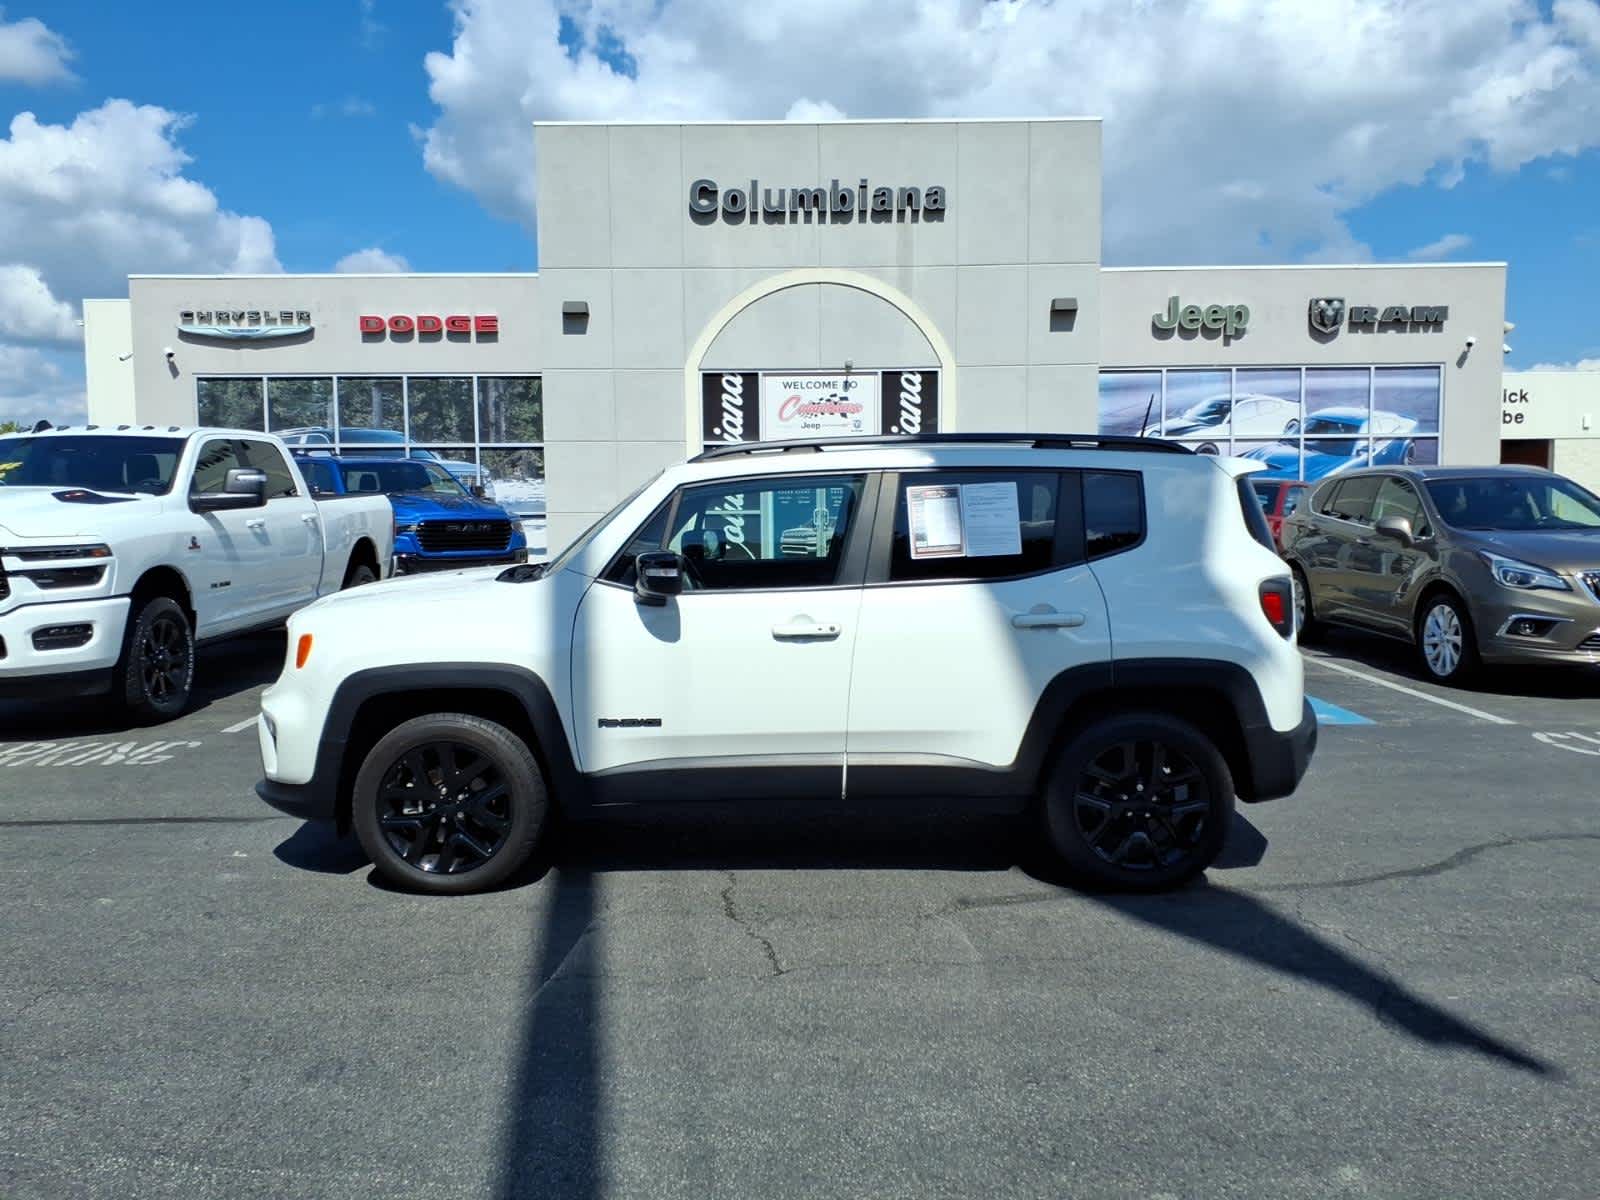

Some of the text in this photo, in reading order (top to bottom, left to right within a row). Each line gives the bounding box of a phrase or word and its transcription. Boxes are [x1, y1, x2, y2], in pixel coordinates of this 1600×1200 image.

[689, 178, 946, 214] Columbiana
[180, 311, 310, 322] CHRYSLER
[1151, 295, 1250, 336] Jeep
[1349, 305, 1449, 322] RAM
[359, 315, 499, 332] DODGE
[782, 381, 839, 390] WELCOME
[1503, 388, 1529, 403] ick
[1502, 409, 1525, 424] be
[800, 421, 821, 431] Jeep
